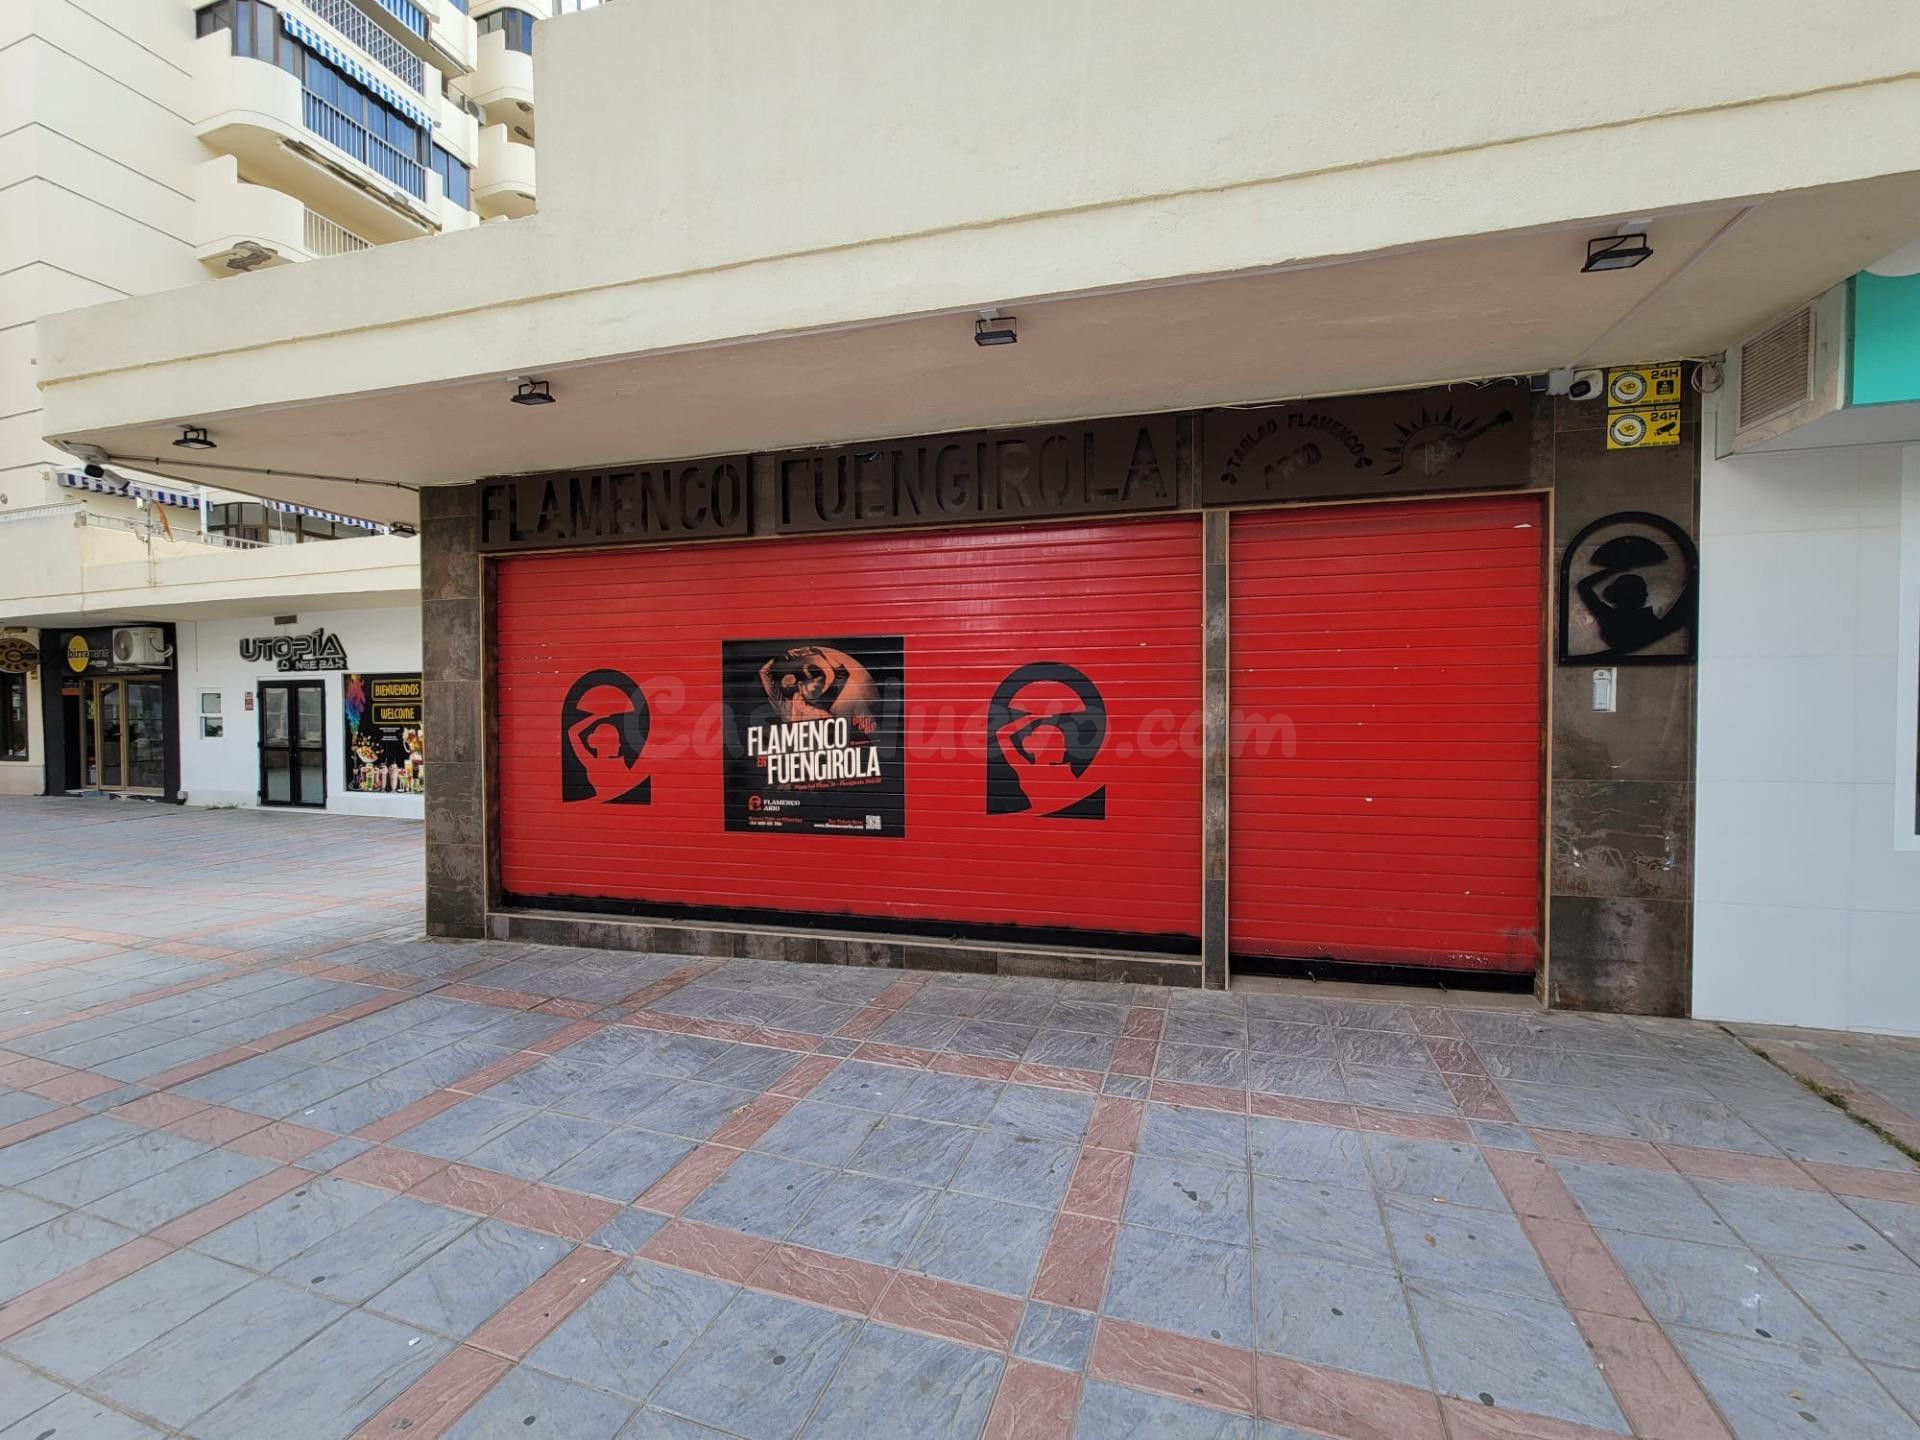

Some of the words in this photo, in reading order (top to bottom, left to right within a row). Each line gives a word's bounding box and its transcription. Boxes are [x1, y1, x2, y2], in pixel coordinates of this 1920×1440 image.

[1651, 368, 1679, 379] 24H
[1650, 411, 1678, 422] 24H
[1287, 413, 1366, 456] FLAMENCO
[481, 463, 741, 543] FLAMENCO
[781, 427, 1168, 525] FUENGIROLA
[239, 627, 348, 662] UTOPÍA
[318, 657, 346, 669] BAR
[380, 707, 415, 720] WELCOME
[747, 717, 848, 756] FLAMENCO
[767, 746, 882, 785] FUENGIROLA
